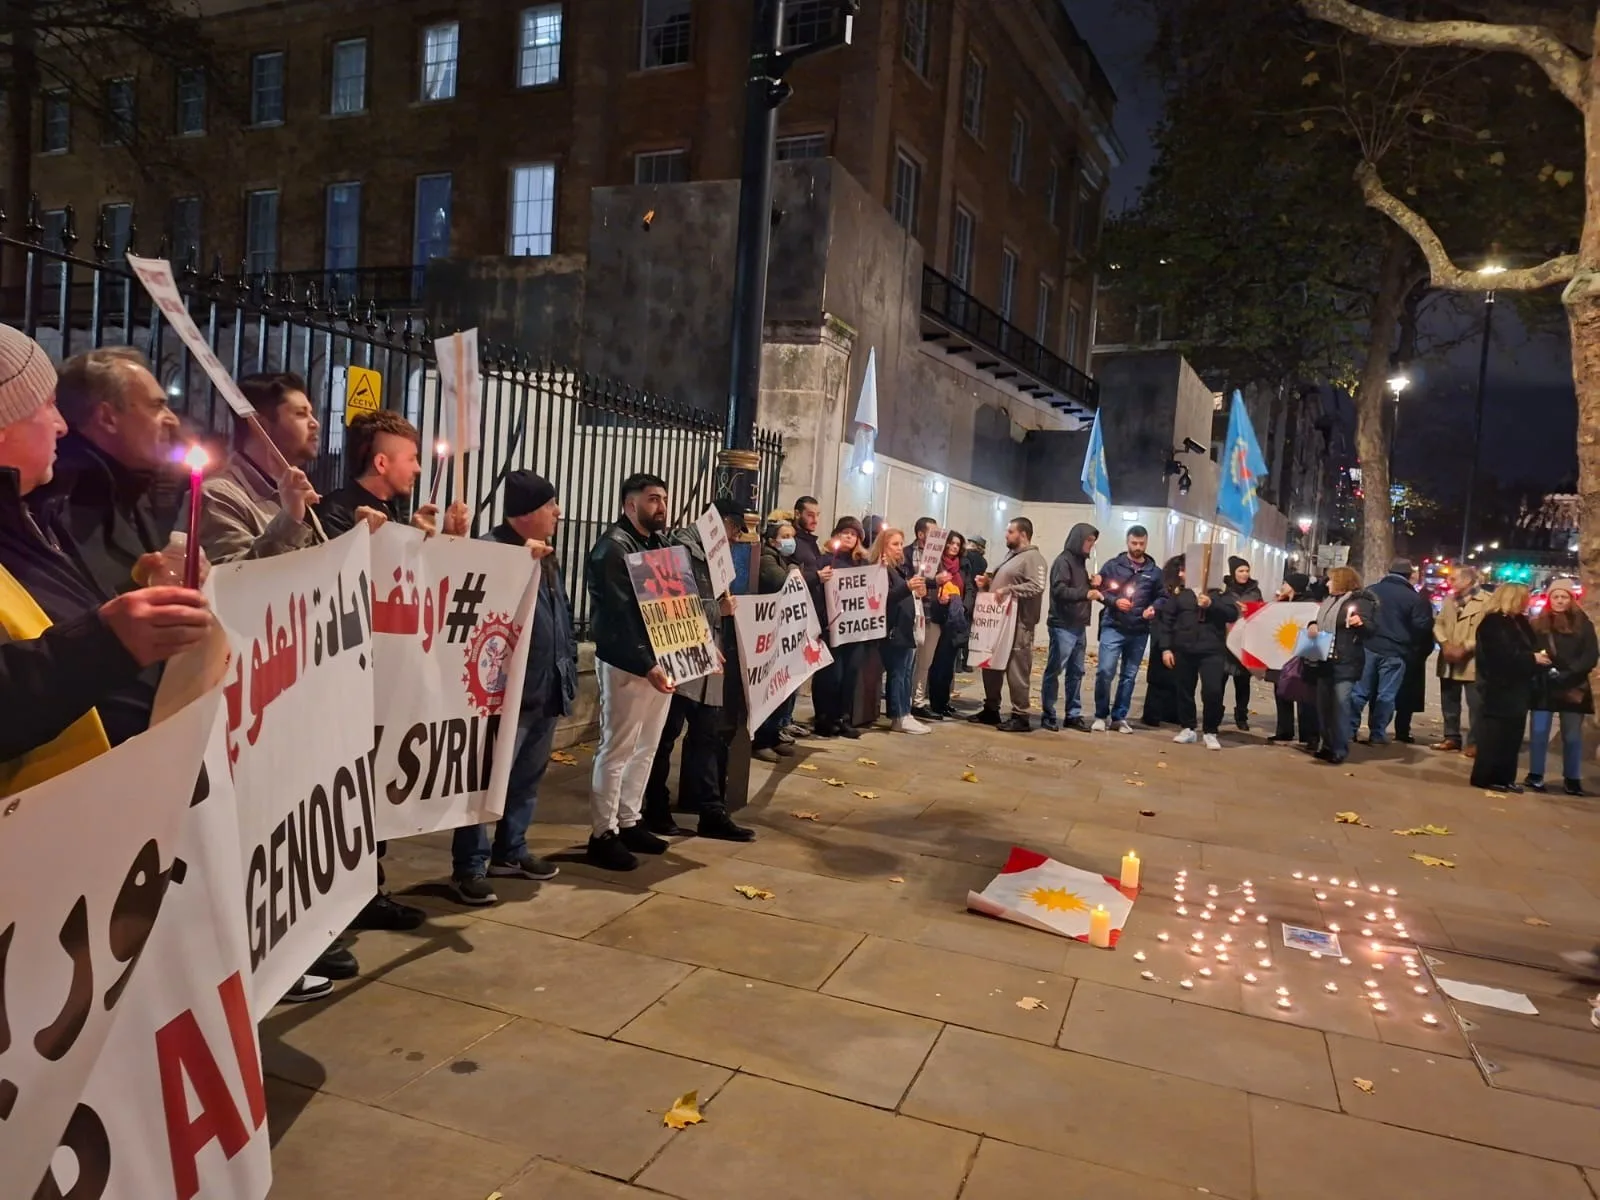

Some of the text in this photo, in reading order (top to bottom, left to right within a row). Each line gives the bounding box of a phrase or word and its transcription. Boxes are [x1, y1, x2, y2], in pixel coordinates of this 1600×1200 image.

[838, 574, 867, 591] FREE
[642, 601, 668, 625] STOP
[841, 597, 866, 612] THE
[651, 619, 701, 647] GENOCIDE
[838, 615, 885, 635] STAGES
[755, 630, 774, 654] BE
[658, 643, 713, 681] IN SYRIA
[246, 752, 375, 974] GENOCI
